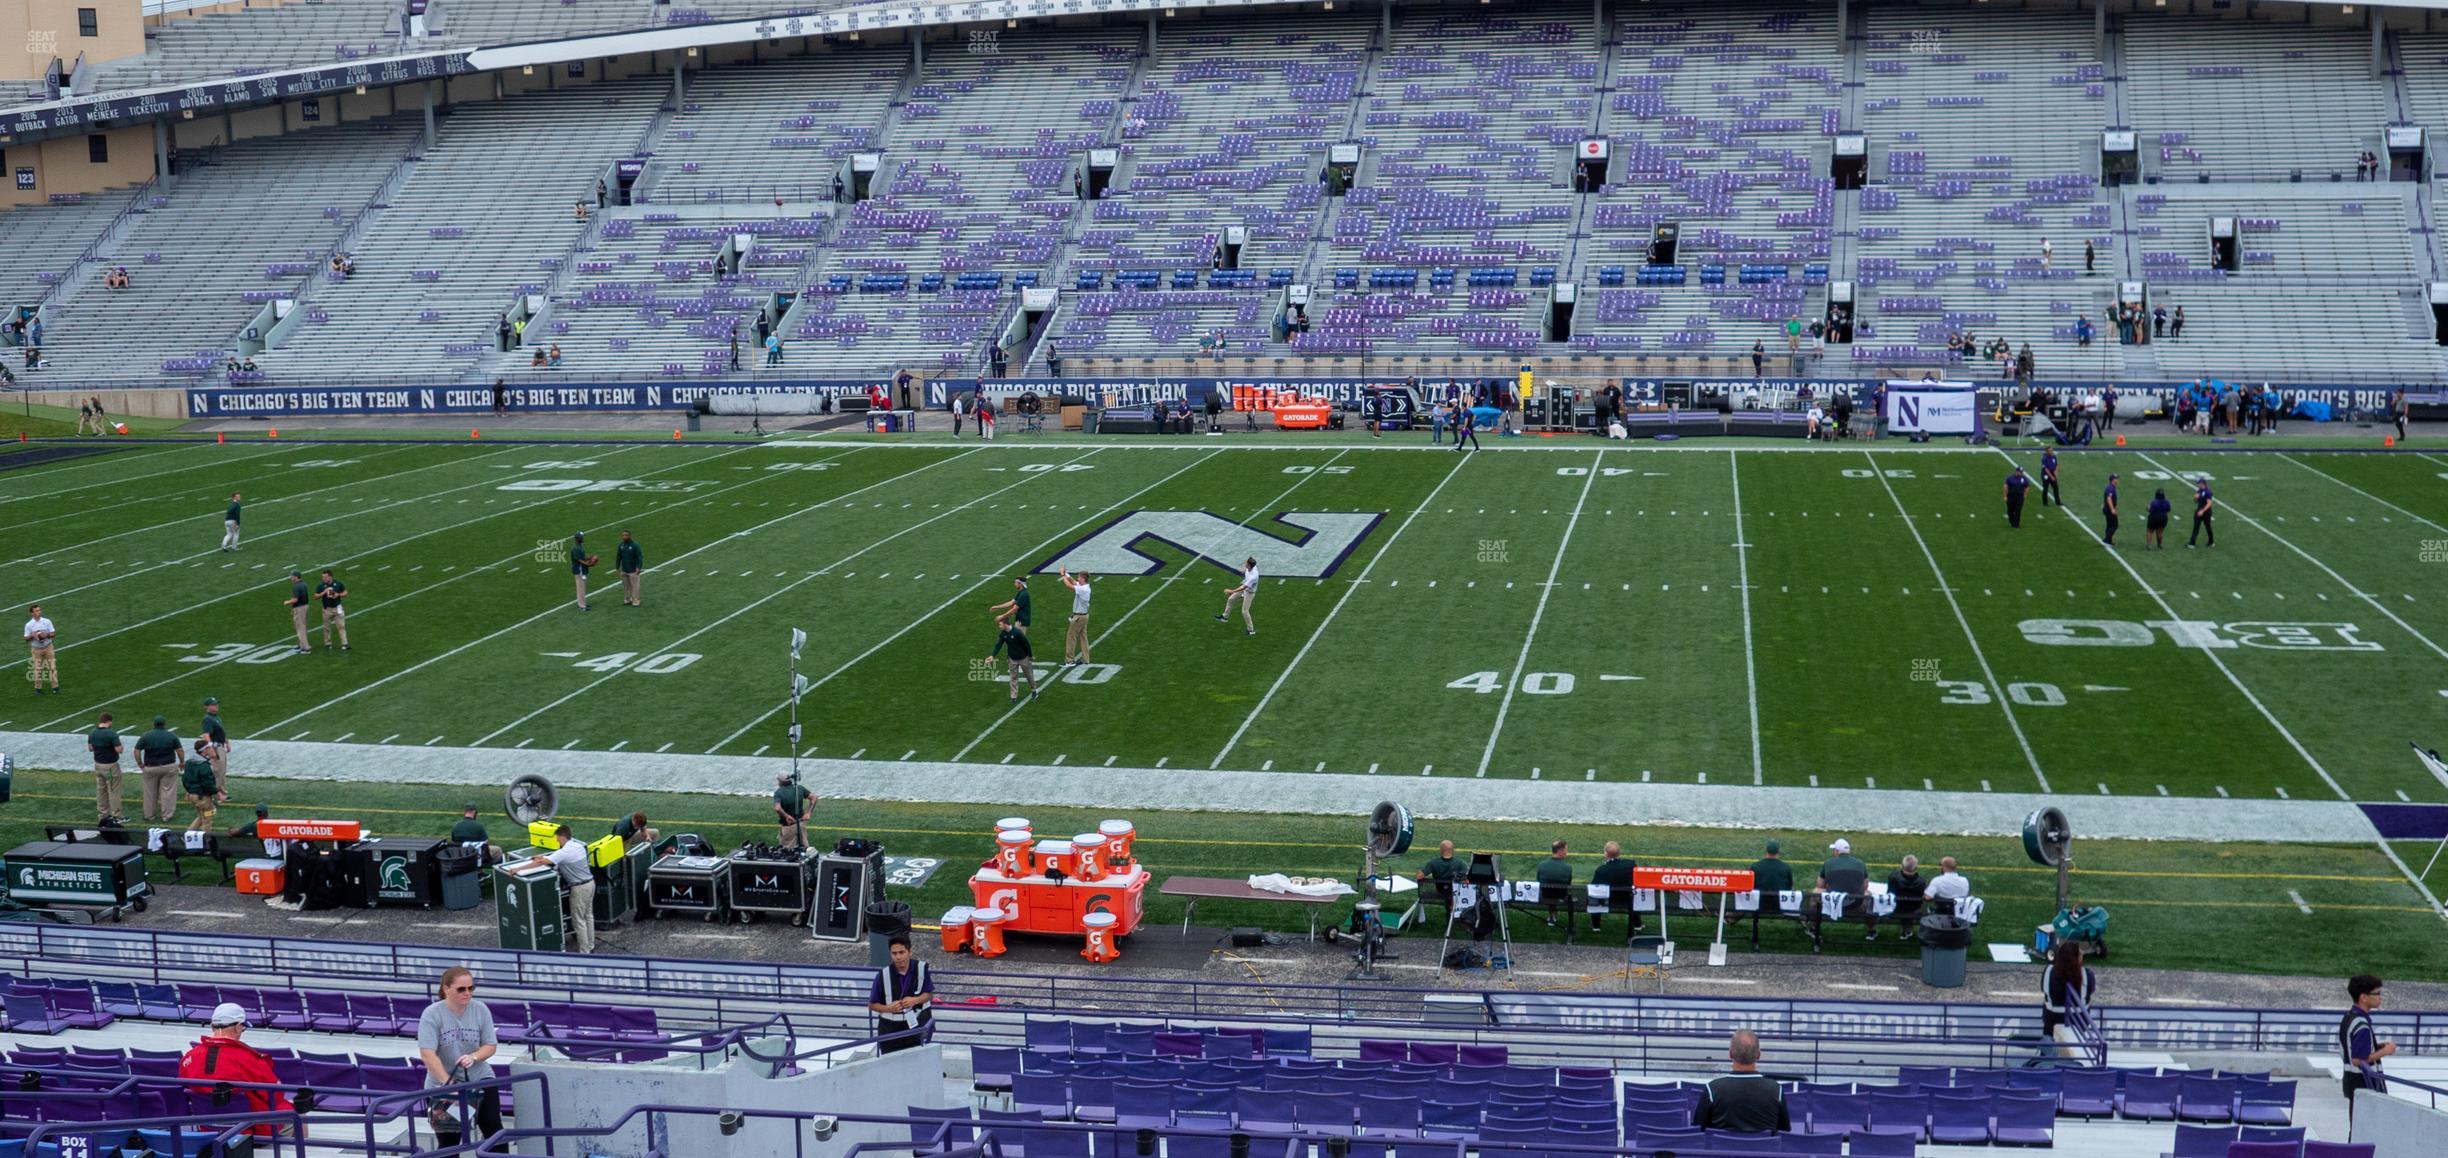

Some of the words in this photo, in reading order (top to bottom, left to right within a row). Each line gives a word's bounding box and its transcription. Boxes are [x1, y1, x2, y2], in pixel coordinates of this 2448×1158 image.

[381, 69, 408, 81] CITRUS
[417, 65, 436, 76] ROSE
[346, 73, 372, 85] ALAMO
[262, 87, 278, 97] SUN
[288, 82, 313, 93] MOTOR
[319, 79, 337, 89] CITY
[180, 95, 214, 108] OUTBACK
[224, 91, 250, 103] ALAMO
[87, 109, 120, 121] MEINEKE
[128, 103, 170, 116] TICKETCITY
[15, 120, 47, 132] OUTBACK
[55, 115, 79, 127] GATOR
[18, 174, 34, 183] 123
[421, 389, 434, 409] N
[446, 390, 525, 407] CHICAO'S
[528, 389, 555, 405] BIG
[558, 389, 588, 405] TEN
[592, 388, 635, 405] TEAM
[648, 386, 660, 405] N
[932, 382, 946, 403] N
[194, 393, 207, 412] N
[219, 394, 298, 410] CHICAGO'S
[302, 393, 328, 409] BIG
[332, 392, 362, 408] TEN
[366, 391, 409, 408] TEAM
[1898, 396, 1919, 427] N
[177, 643, 305, 664] 30
[572, 652, 703, 673] 40
[1446, 671, 1576, 695] 40
[1936, 681, 2068, 706] 30
[279, 825, 334, 837] GATORADE
[1004, 848, 1016, 862] G
[1082, 851, 1094, 864] G
[1046, 857, 1058, 869] G
[38, 870, 77, 881] MICHIGAN
[78, 872, 102, 882] STATE
[250, 872, 260, 884] G
[1661, 874, 1727, 887] GATORADE
[39, 881, 102, 890] ATHLETICS
[1090, 931, 1102, 945] G
[62, 1136, 87, 1147] BOX
